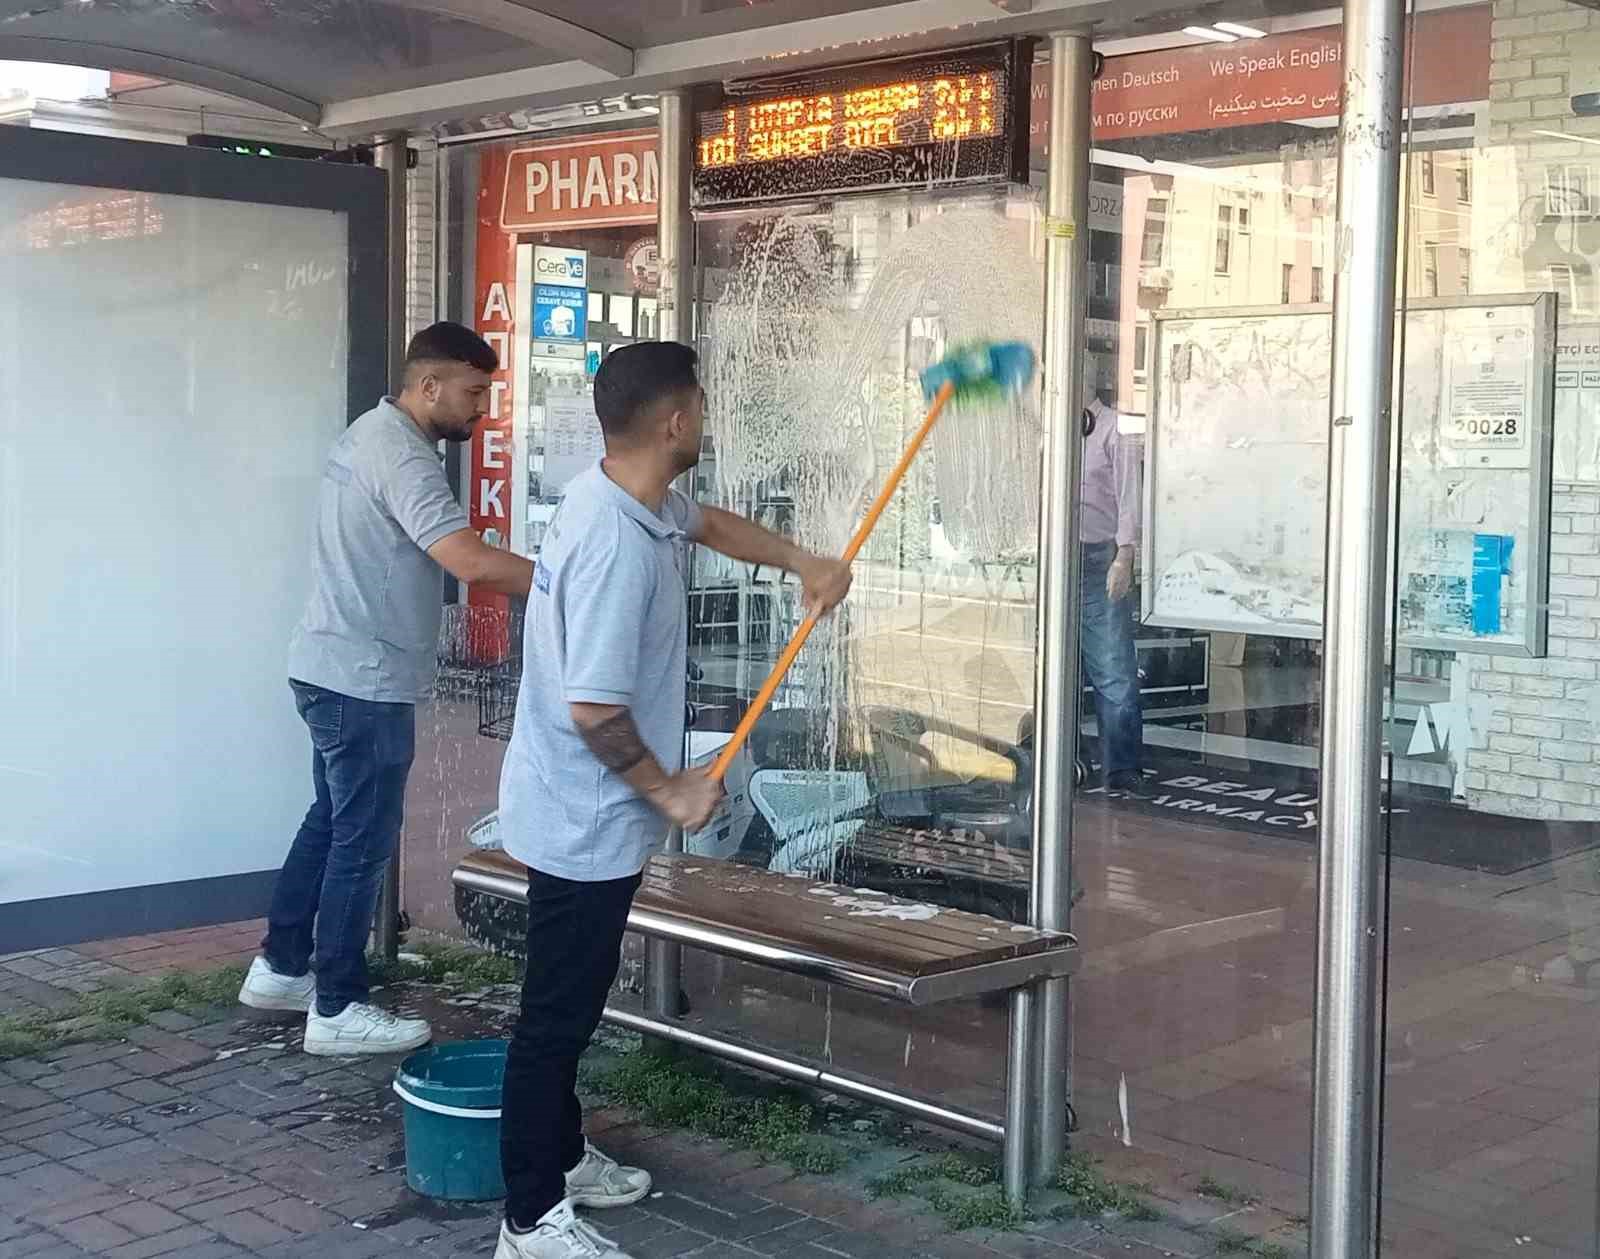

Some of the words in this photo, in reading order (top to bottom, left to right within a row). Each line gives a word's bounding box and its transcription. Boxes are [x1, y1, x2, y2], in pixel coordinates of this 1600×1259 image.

[1209, 59, 1234, 76] We
[1239, 50, 1285, 78] Speak
[1030, 83, 1048, 100] Wi
[1123, 65, 1180, 88] Deutsch
[1261, 90, 1307, 112] صحبت
[1107, 113, 1125, 127] по
[1129, 105, 1179, 128] русски
[1089, 195, 1120, 217] ORZ
[537, 255, 584, 278] CeraVe
[1455, 418, 1517, 436] 20028
